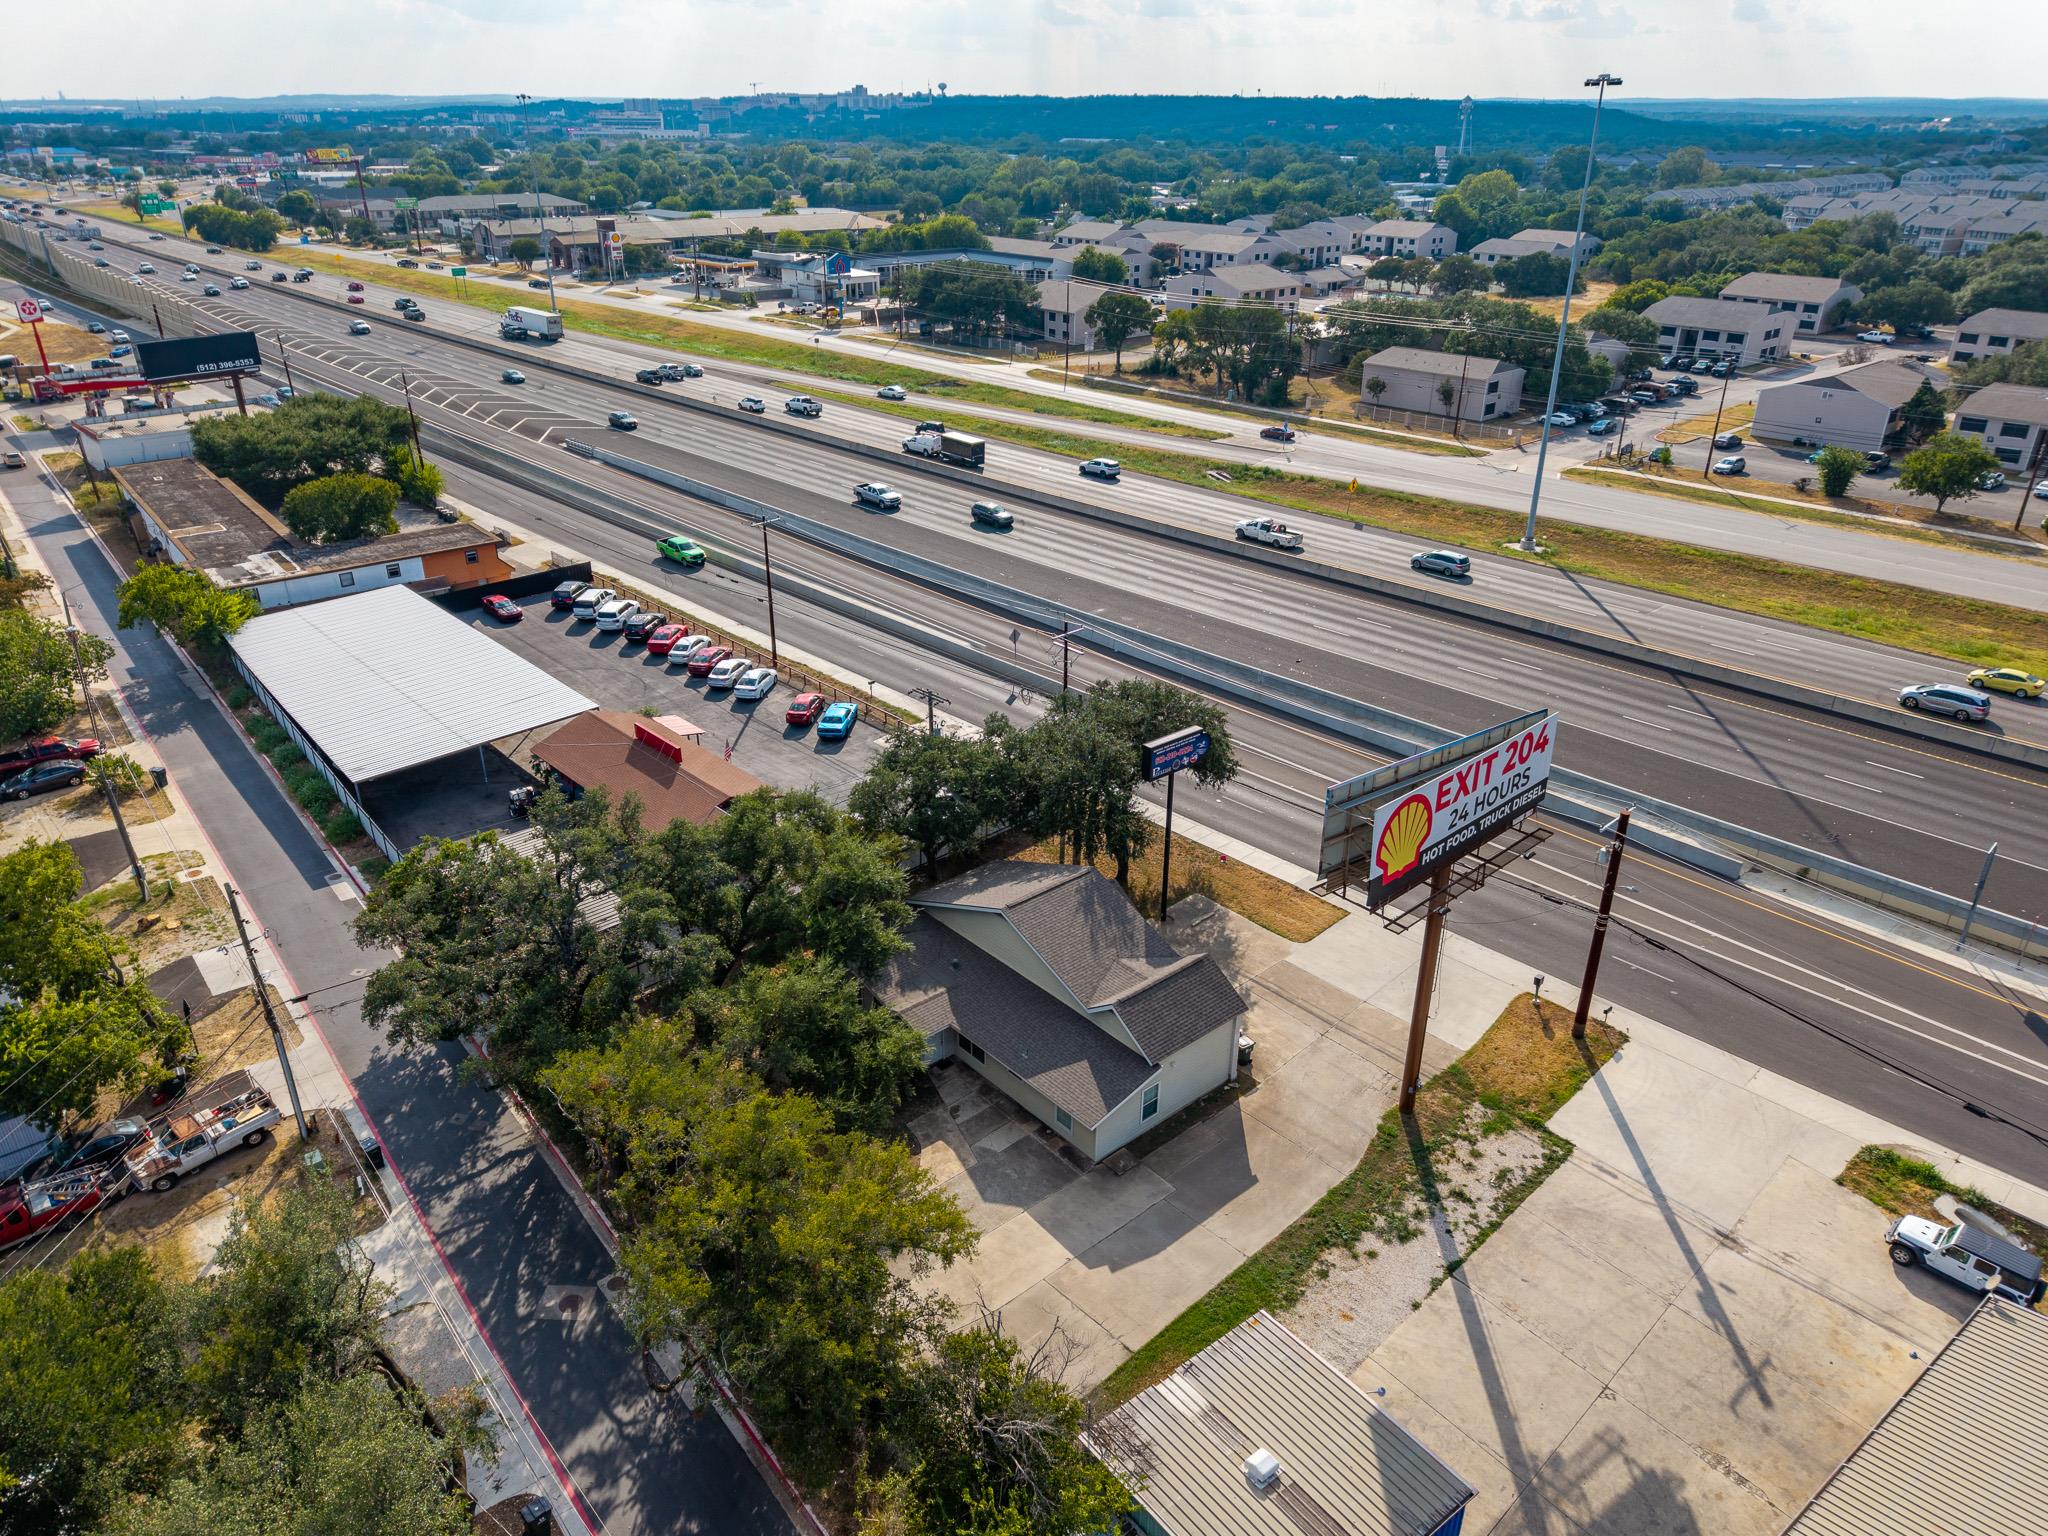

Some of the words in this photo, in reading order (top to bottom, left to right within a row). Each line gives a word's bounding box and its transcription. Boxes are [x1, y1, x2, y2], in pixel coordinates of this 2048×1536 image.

[508, 310, 523, 323] FedEx
[196, 363, 217, 373] (512)
[1435, 751, 1499, 813] EXIT
[1502, 723, 1549, 775] 204
[1448, 803, 1468, 831] 24
[1473, 766, 1532, 816] HOURS
[1422, 842, 1446, 865] HOT
[1446, 825, 1477, 851] FOOD.
[1479, 802, 1512, 831] TRUCK
